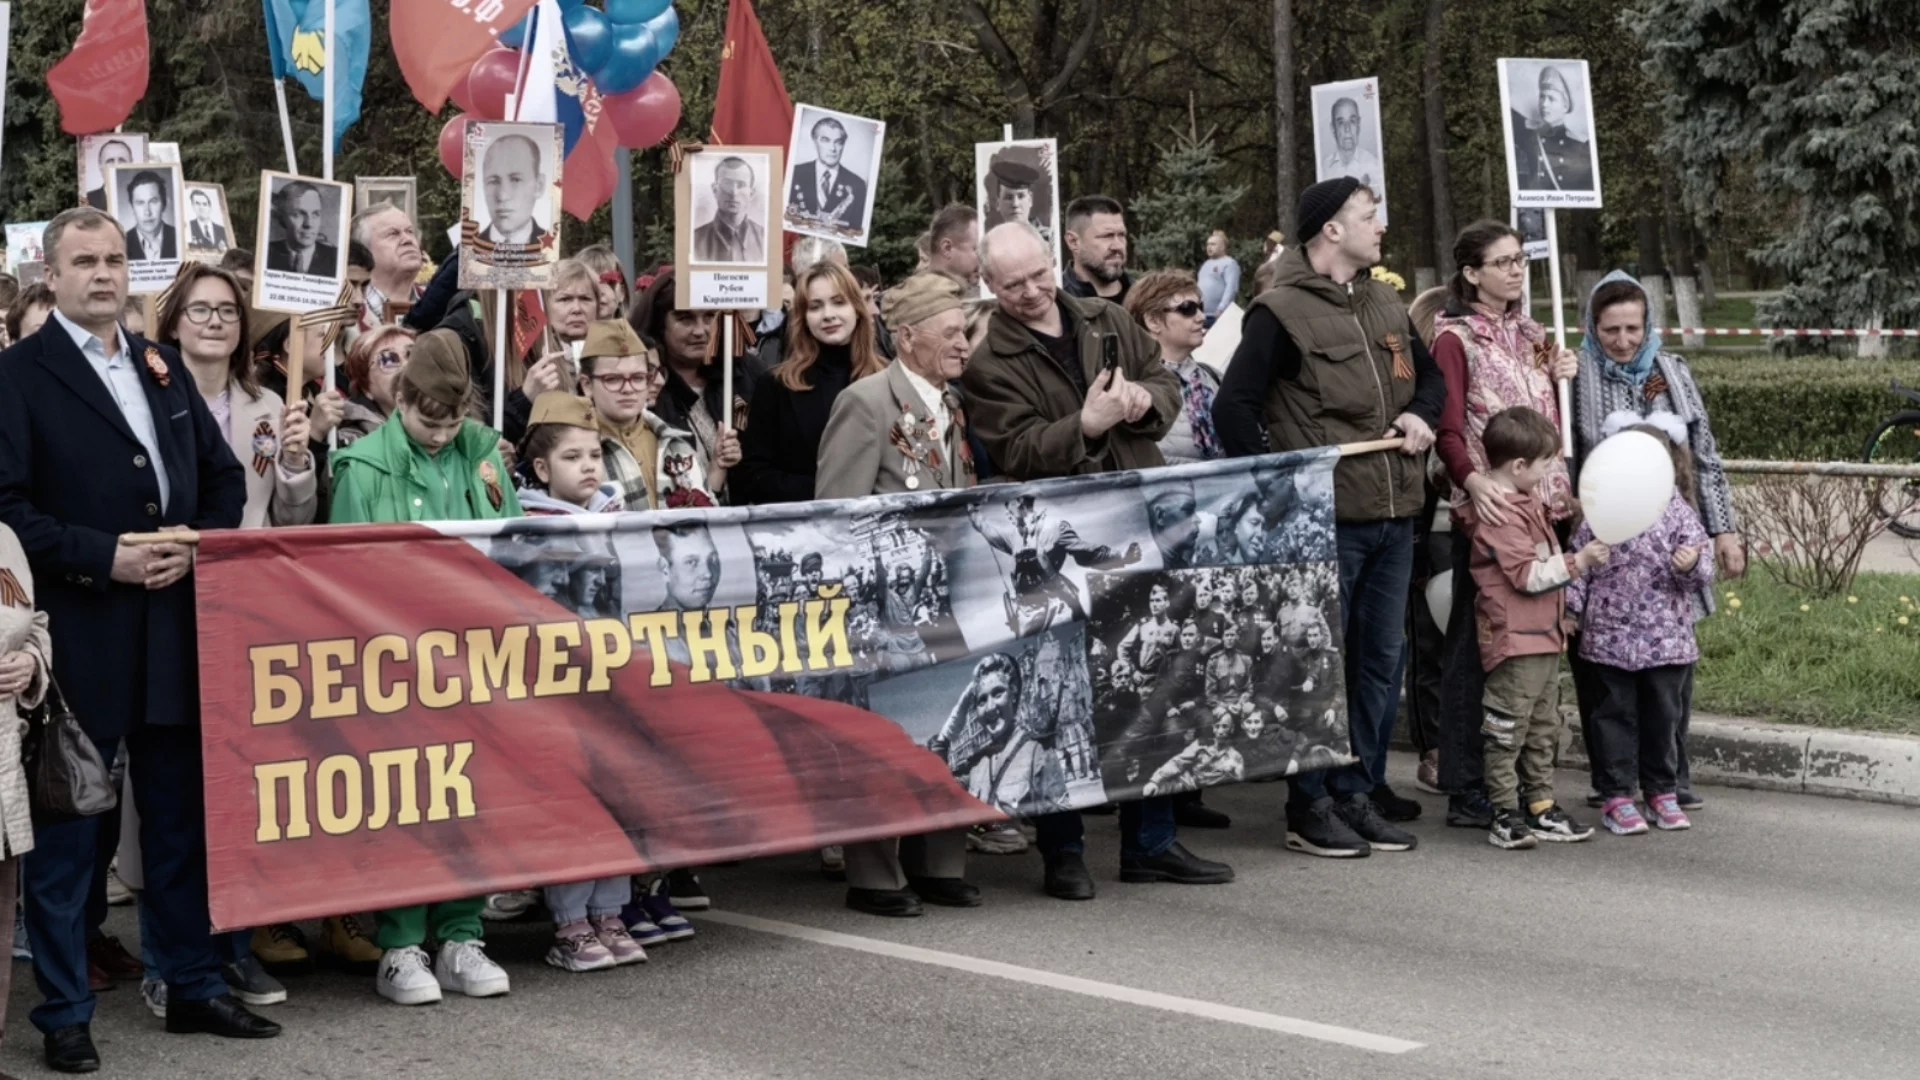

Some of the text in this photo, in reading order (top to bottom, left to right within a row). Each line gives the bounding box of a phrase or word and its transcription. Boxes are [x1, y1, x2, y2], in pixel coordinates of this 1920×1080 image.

[713, 273, 749, 281] Погосян
[718, 284, 744, 294] Рубен
[702, 295, 760, 305] Карапетович
[249, 583, 854, 725] БЕССМЕРТНЫЙ
[254, 741, 476, 842] ПОЛК
